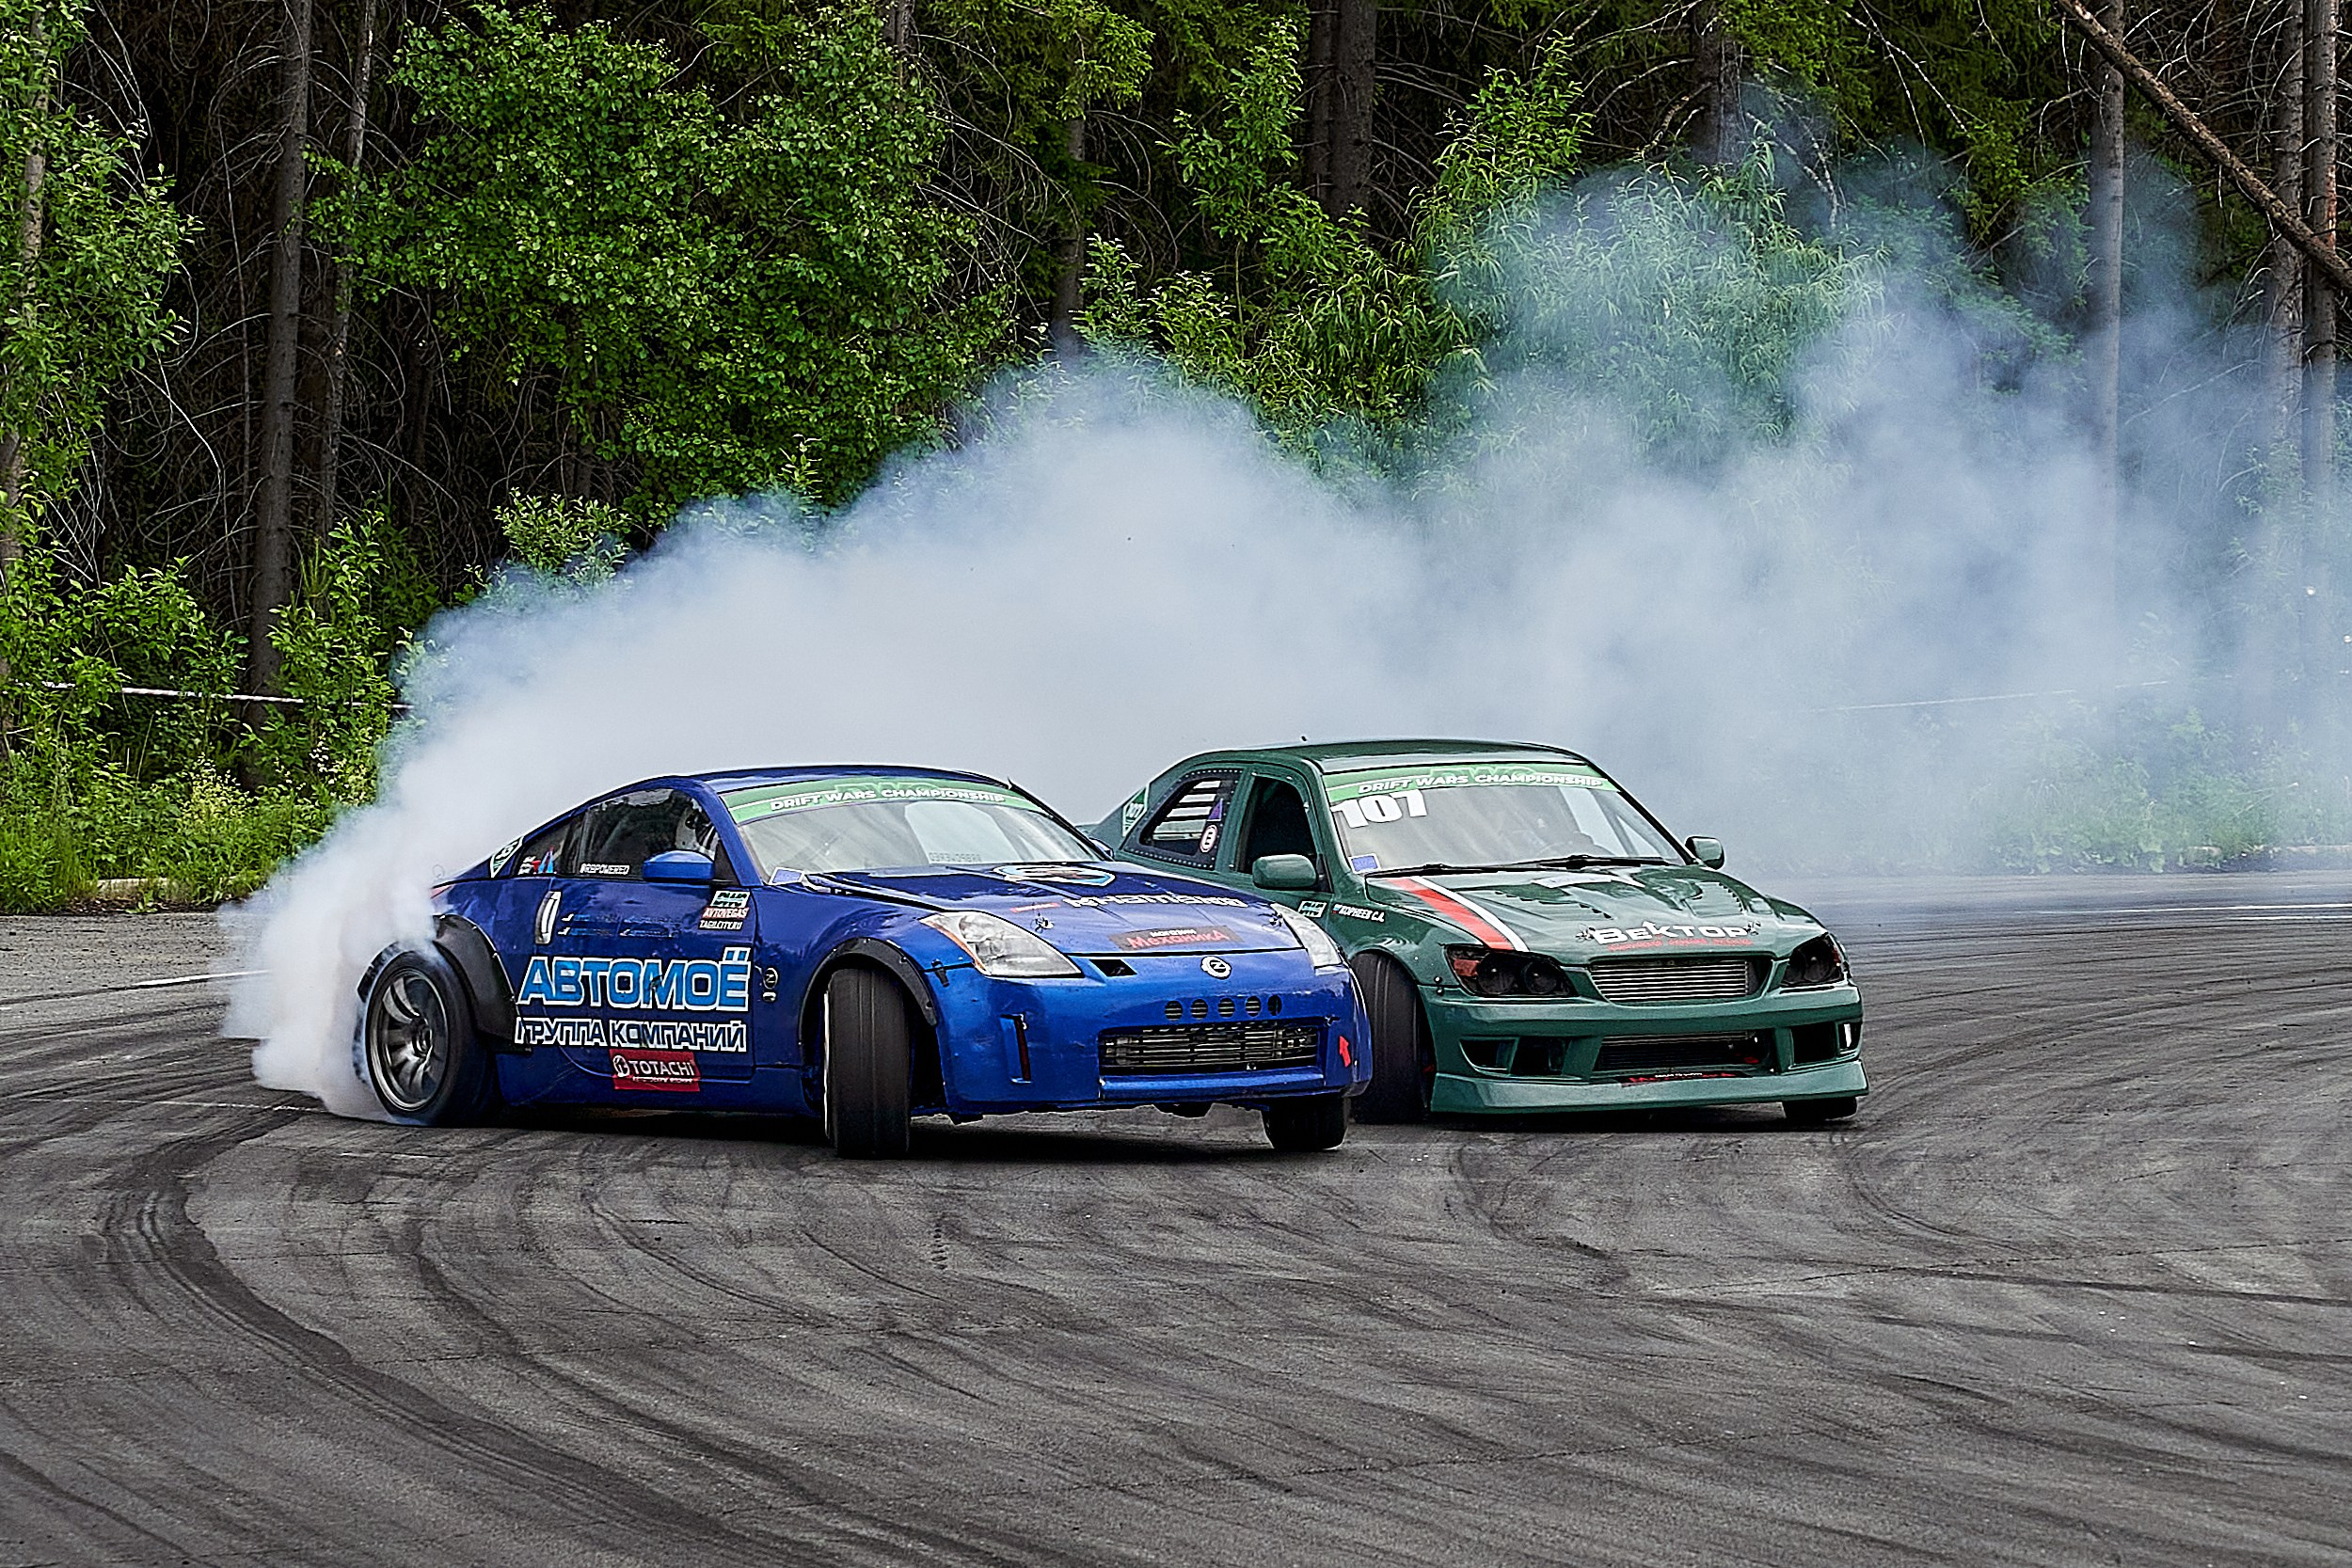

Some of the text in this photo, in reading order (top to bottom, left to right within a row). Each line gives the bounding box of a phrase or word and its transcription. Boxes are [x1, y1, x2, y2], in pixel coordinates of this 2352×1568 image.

[1358, 774, 1603, 794] DRIFT WARS CHAMPIONSHIP
[771, 790, 1006, 811] DRIFT WARS CHAMPIONSHIP
[703, 908, 750, 919] AVTOVEGAS
[516, 947, 751, 1011] АВТОМОЁ
[515, 1017, 747, 1052] ГРУППА КОМПАНИЙ
